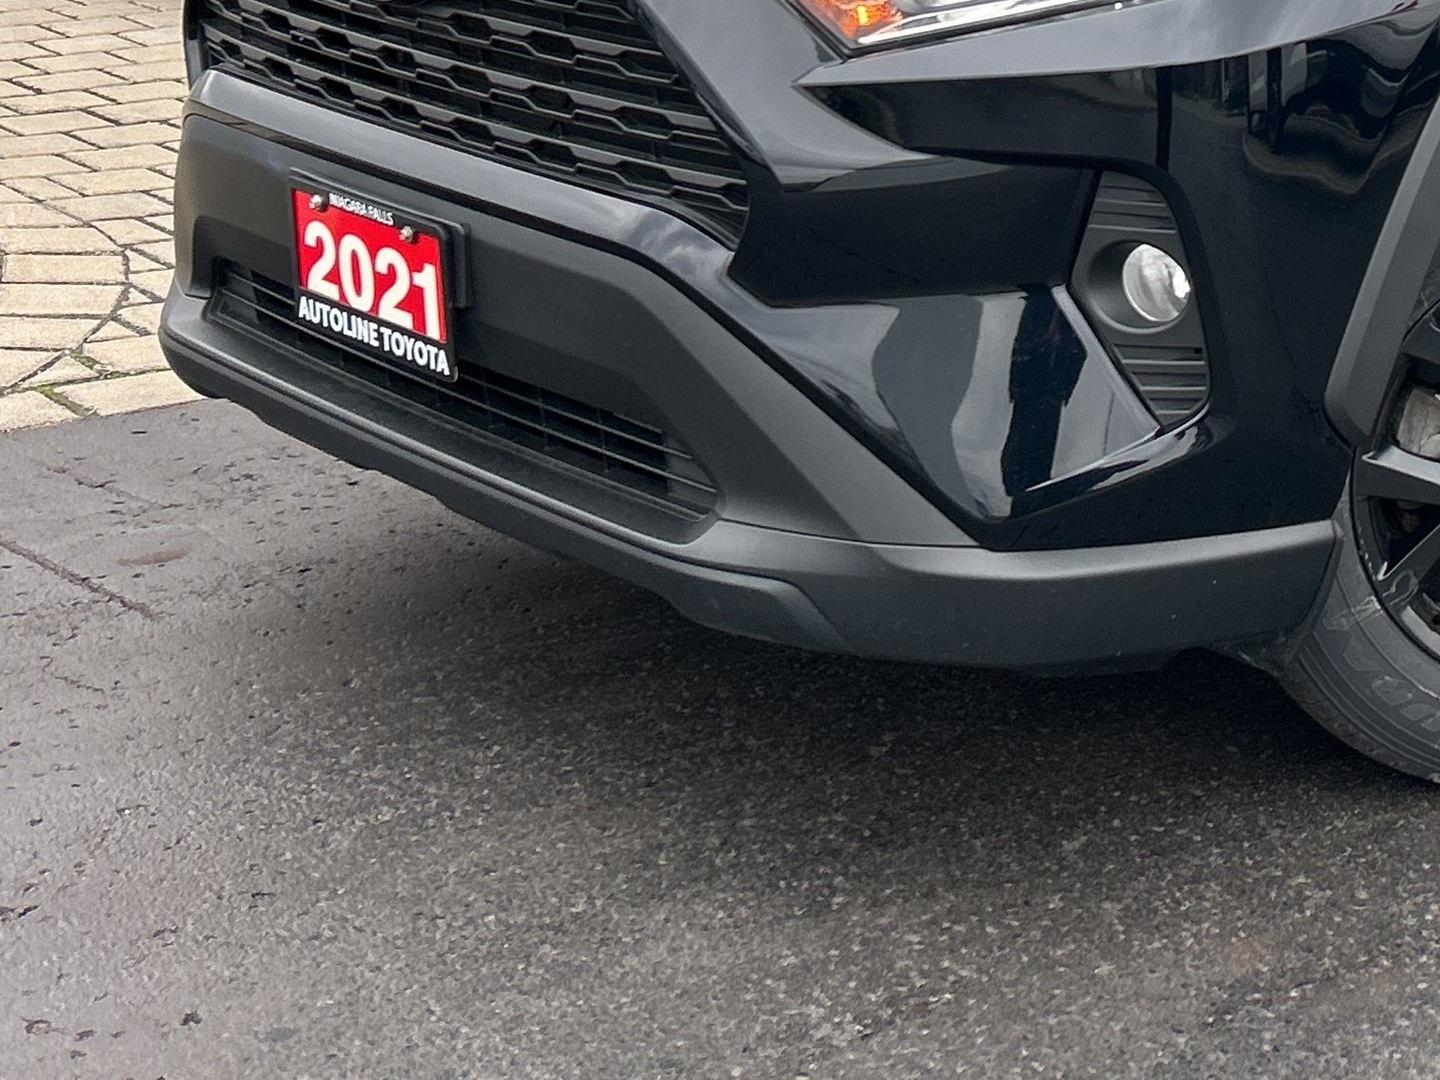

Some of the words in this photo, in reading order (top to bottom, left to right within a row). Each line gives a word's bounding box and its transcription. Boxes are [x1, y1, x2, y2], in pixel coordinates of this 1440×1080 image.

[367, 205, 394, 226] FALLS
[304, 220, 441, 341] 2021
[298, 295, 380, 348] AUTOLINE
[379, 327, 450, 376] TOYOTA
